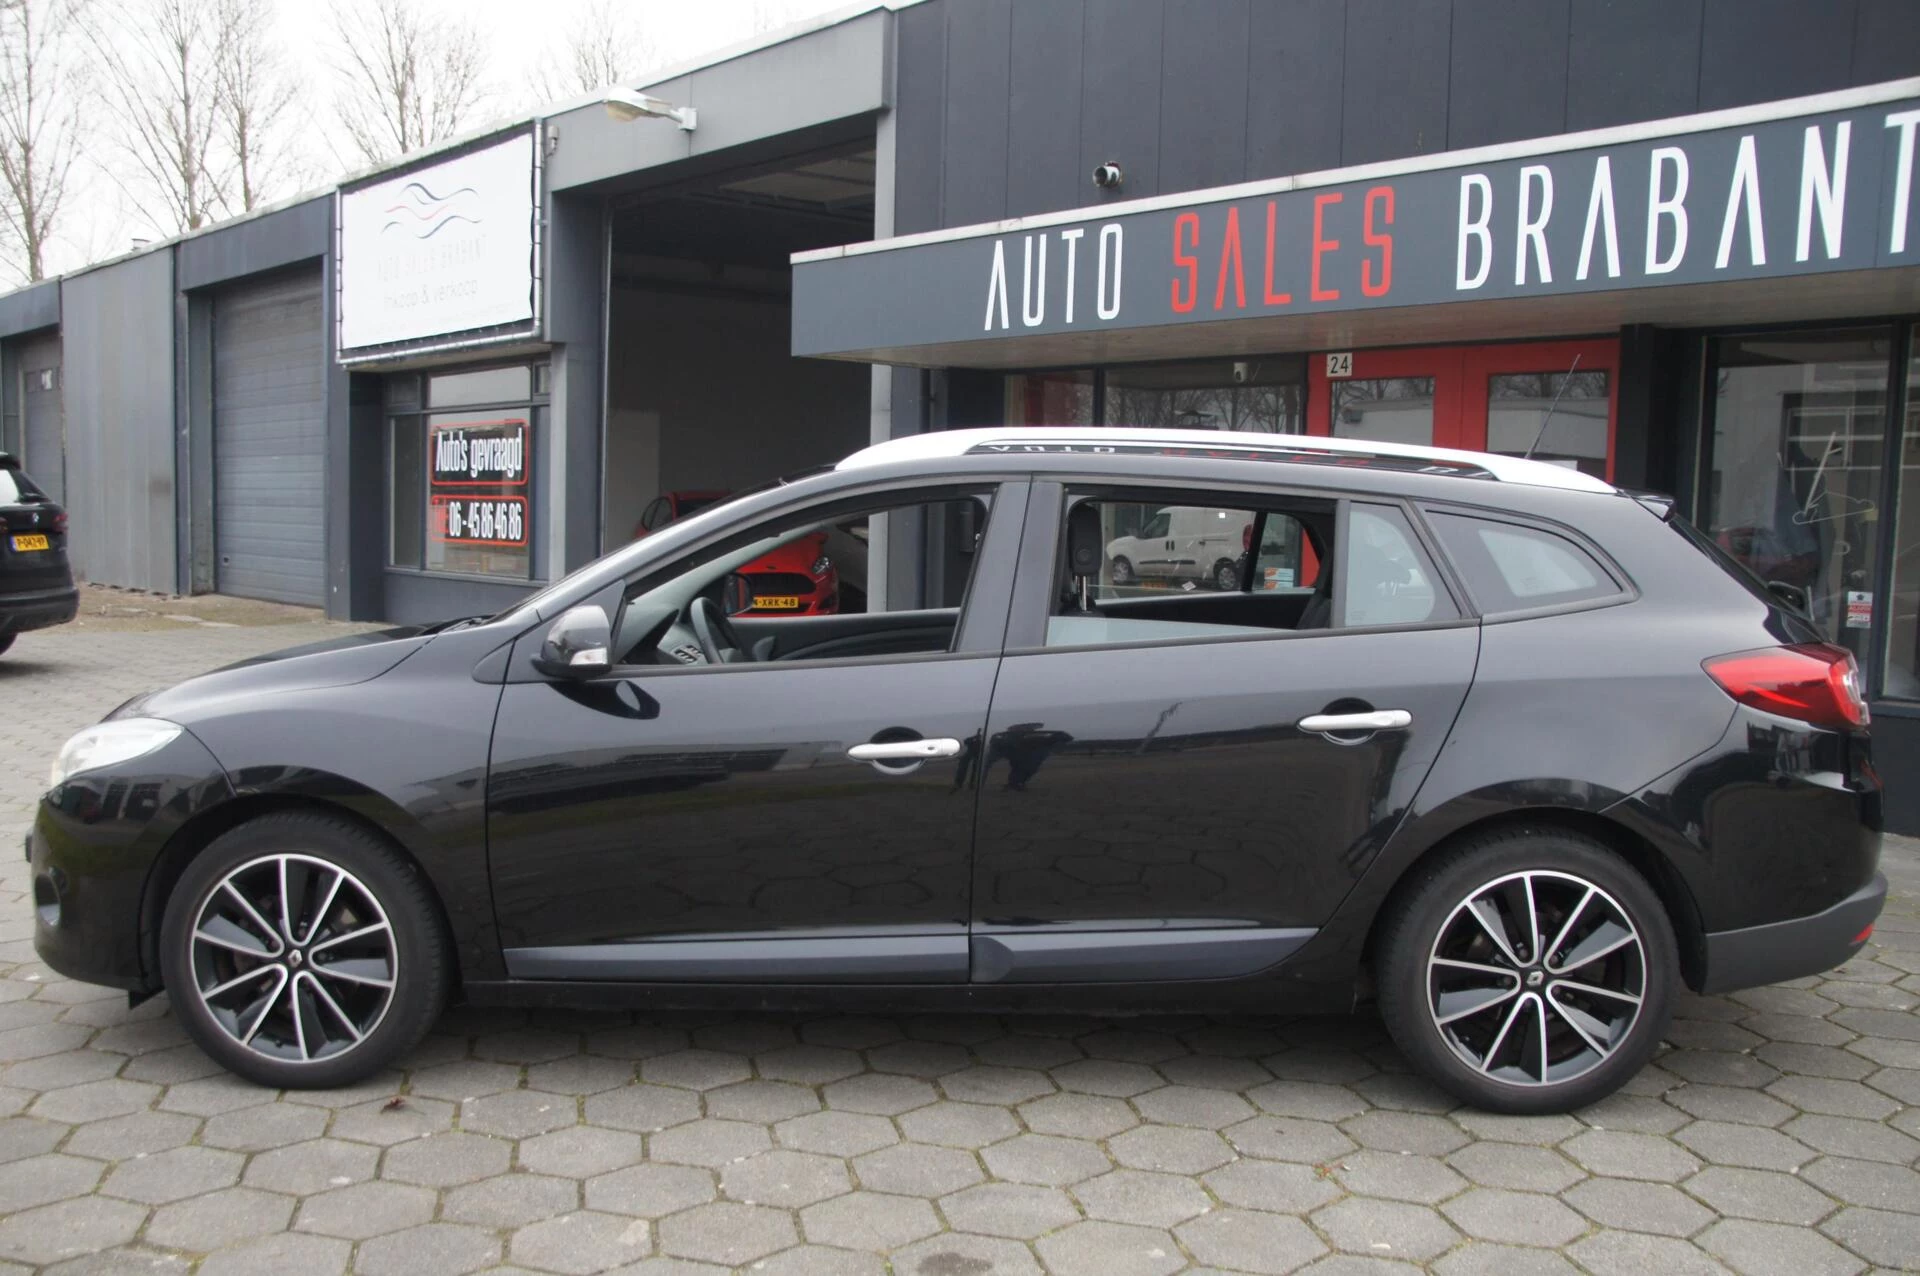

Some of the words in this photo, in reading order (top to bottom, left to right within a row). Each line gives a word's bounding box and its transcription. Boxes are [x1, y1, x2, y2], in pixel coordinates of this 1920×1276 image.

[984, 222, 1123, 331] AUTO
[1171, 185, 1395, 313] SALES
[1456, 108, 1920, 290] BRABANT
[1330, 355, 1349, 374] 24
[435, 430, 468, 472] Auto's
[470, 427, 522, 478] gevraagd
